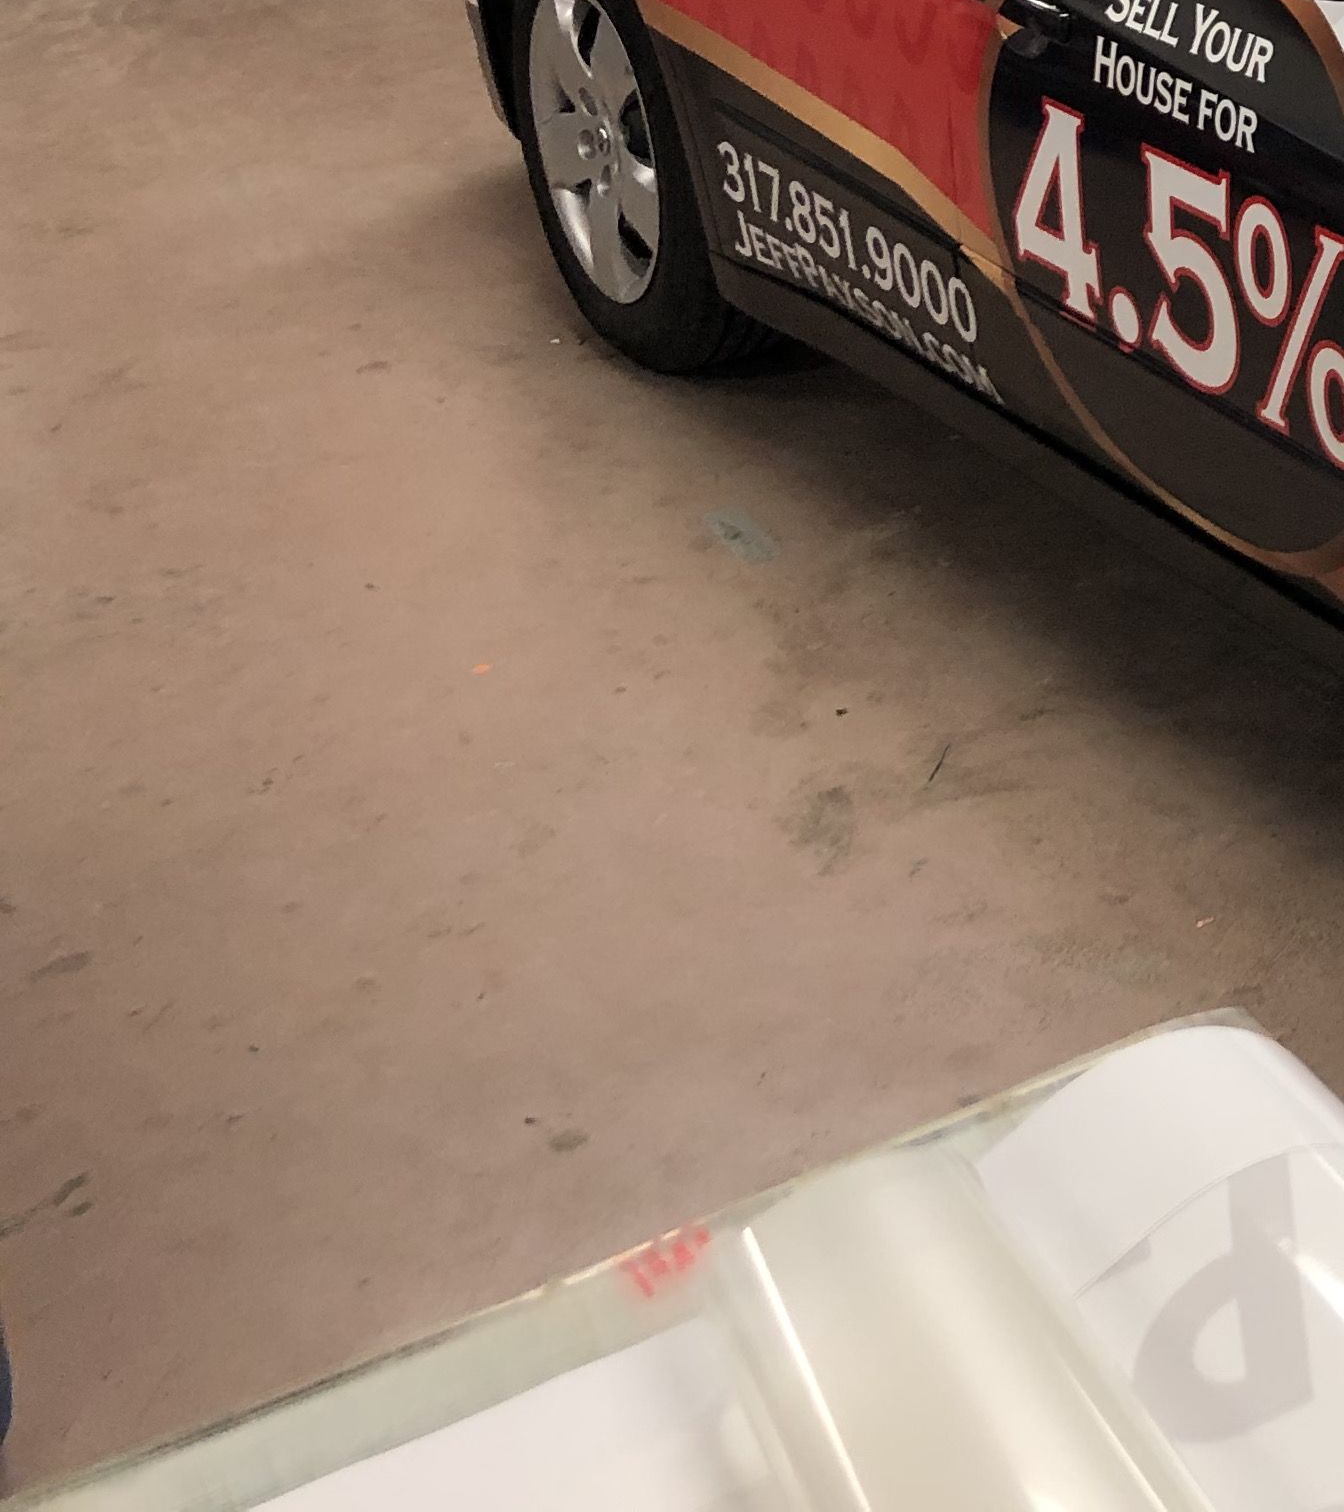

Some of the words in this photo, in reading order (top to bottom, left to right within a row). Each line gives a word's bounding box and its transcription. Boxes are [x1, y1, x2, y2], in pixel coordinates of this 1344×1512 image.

[1093, 36, 1193, 125] HOUSE
[1196, 92, 1259, 154] FOR
[1188, 2, 1275, 84] YOUR
[716, 140, 978, 343] 317.851.9000
